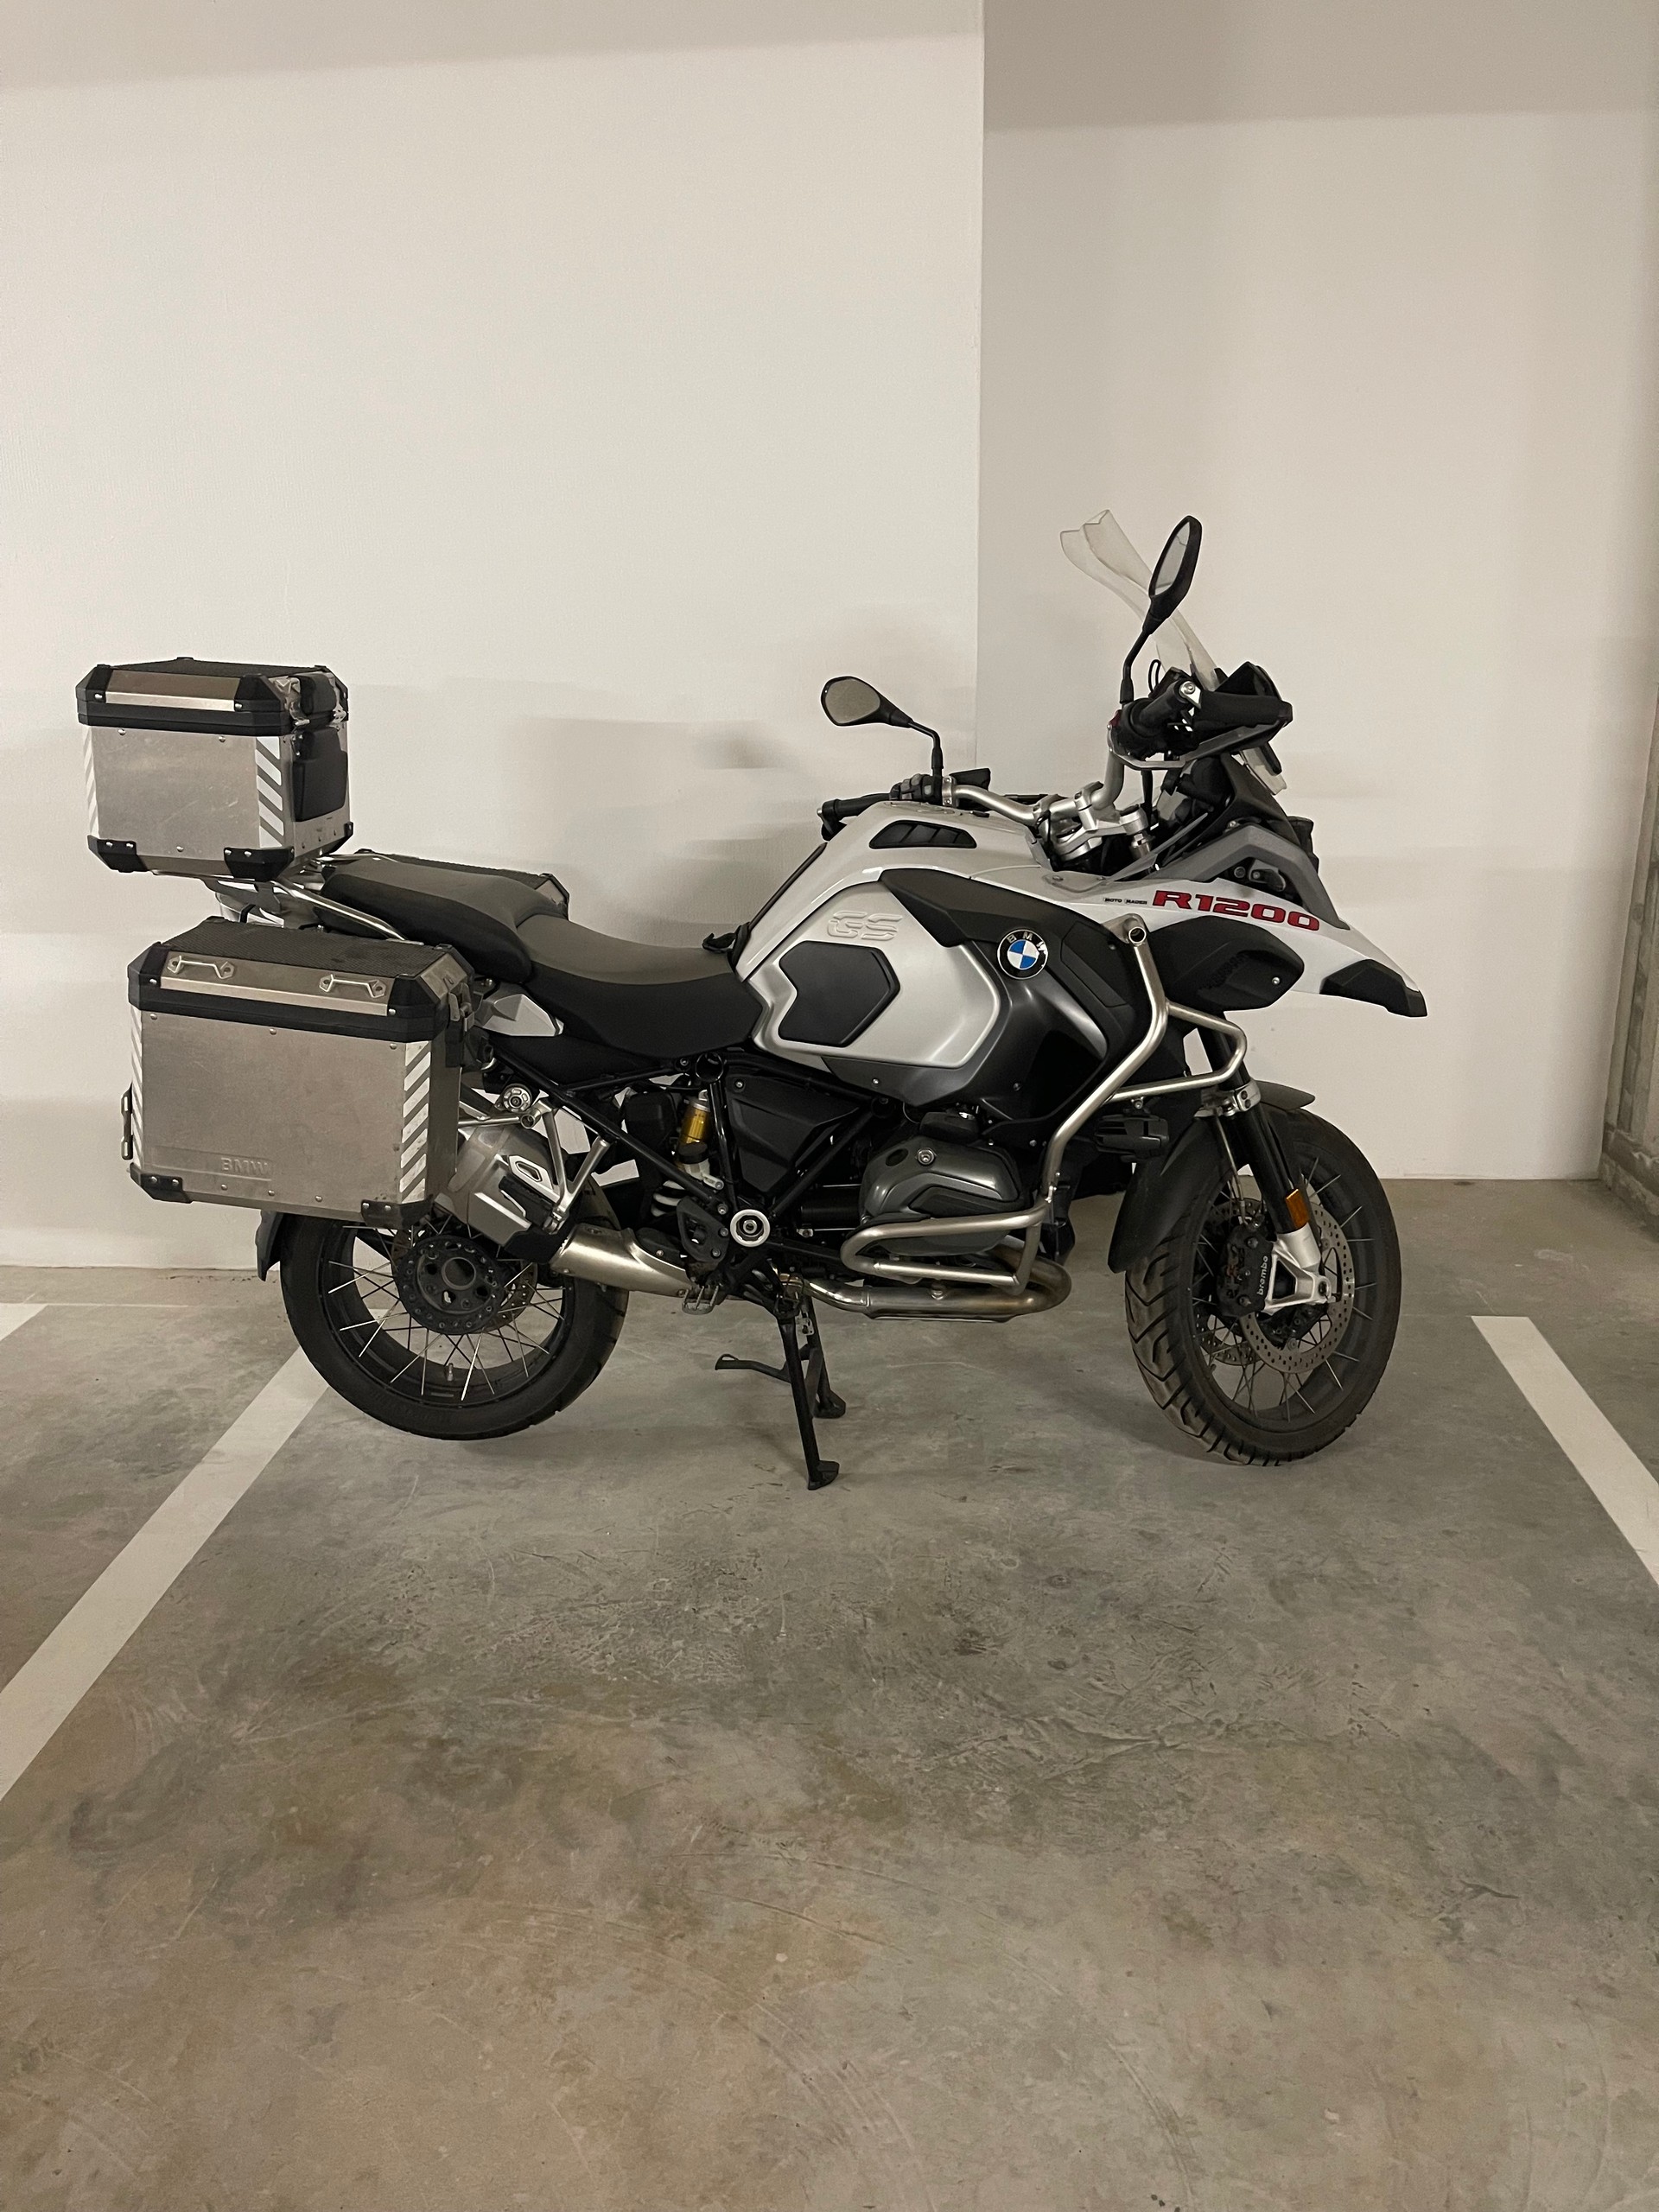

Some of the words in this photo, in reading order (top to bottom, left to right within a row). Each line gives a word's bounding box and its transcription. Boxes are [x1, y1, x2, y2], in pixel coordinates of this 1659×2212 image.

[827, 910, 904, 941] GS
[1152, 890, 1320, 931] R1200
[1006, 931, 1047, 953] BMW
[220, 1157, 269, 1176] BMW
[1256, 1255, 1268, 1295] brembo
